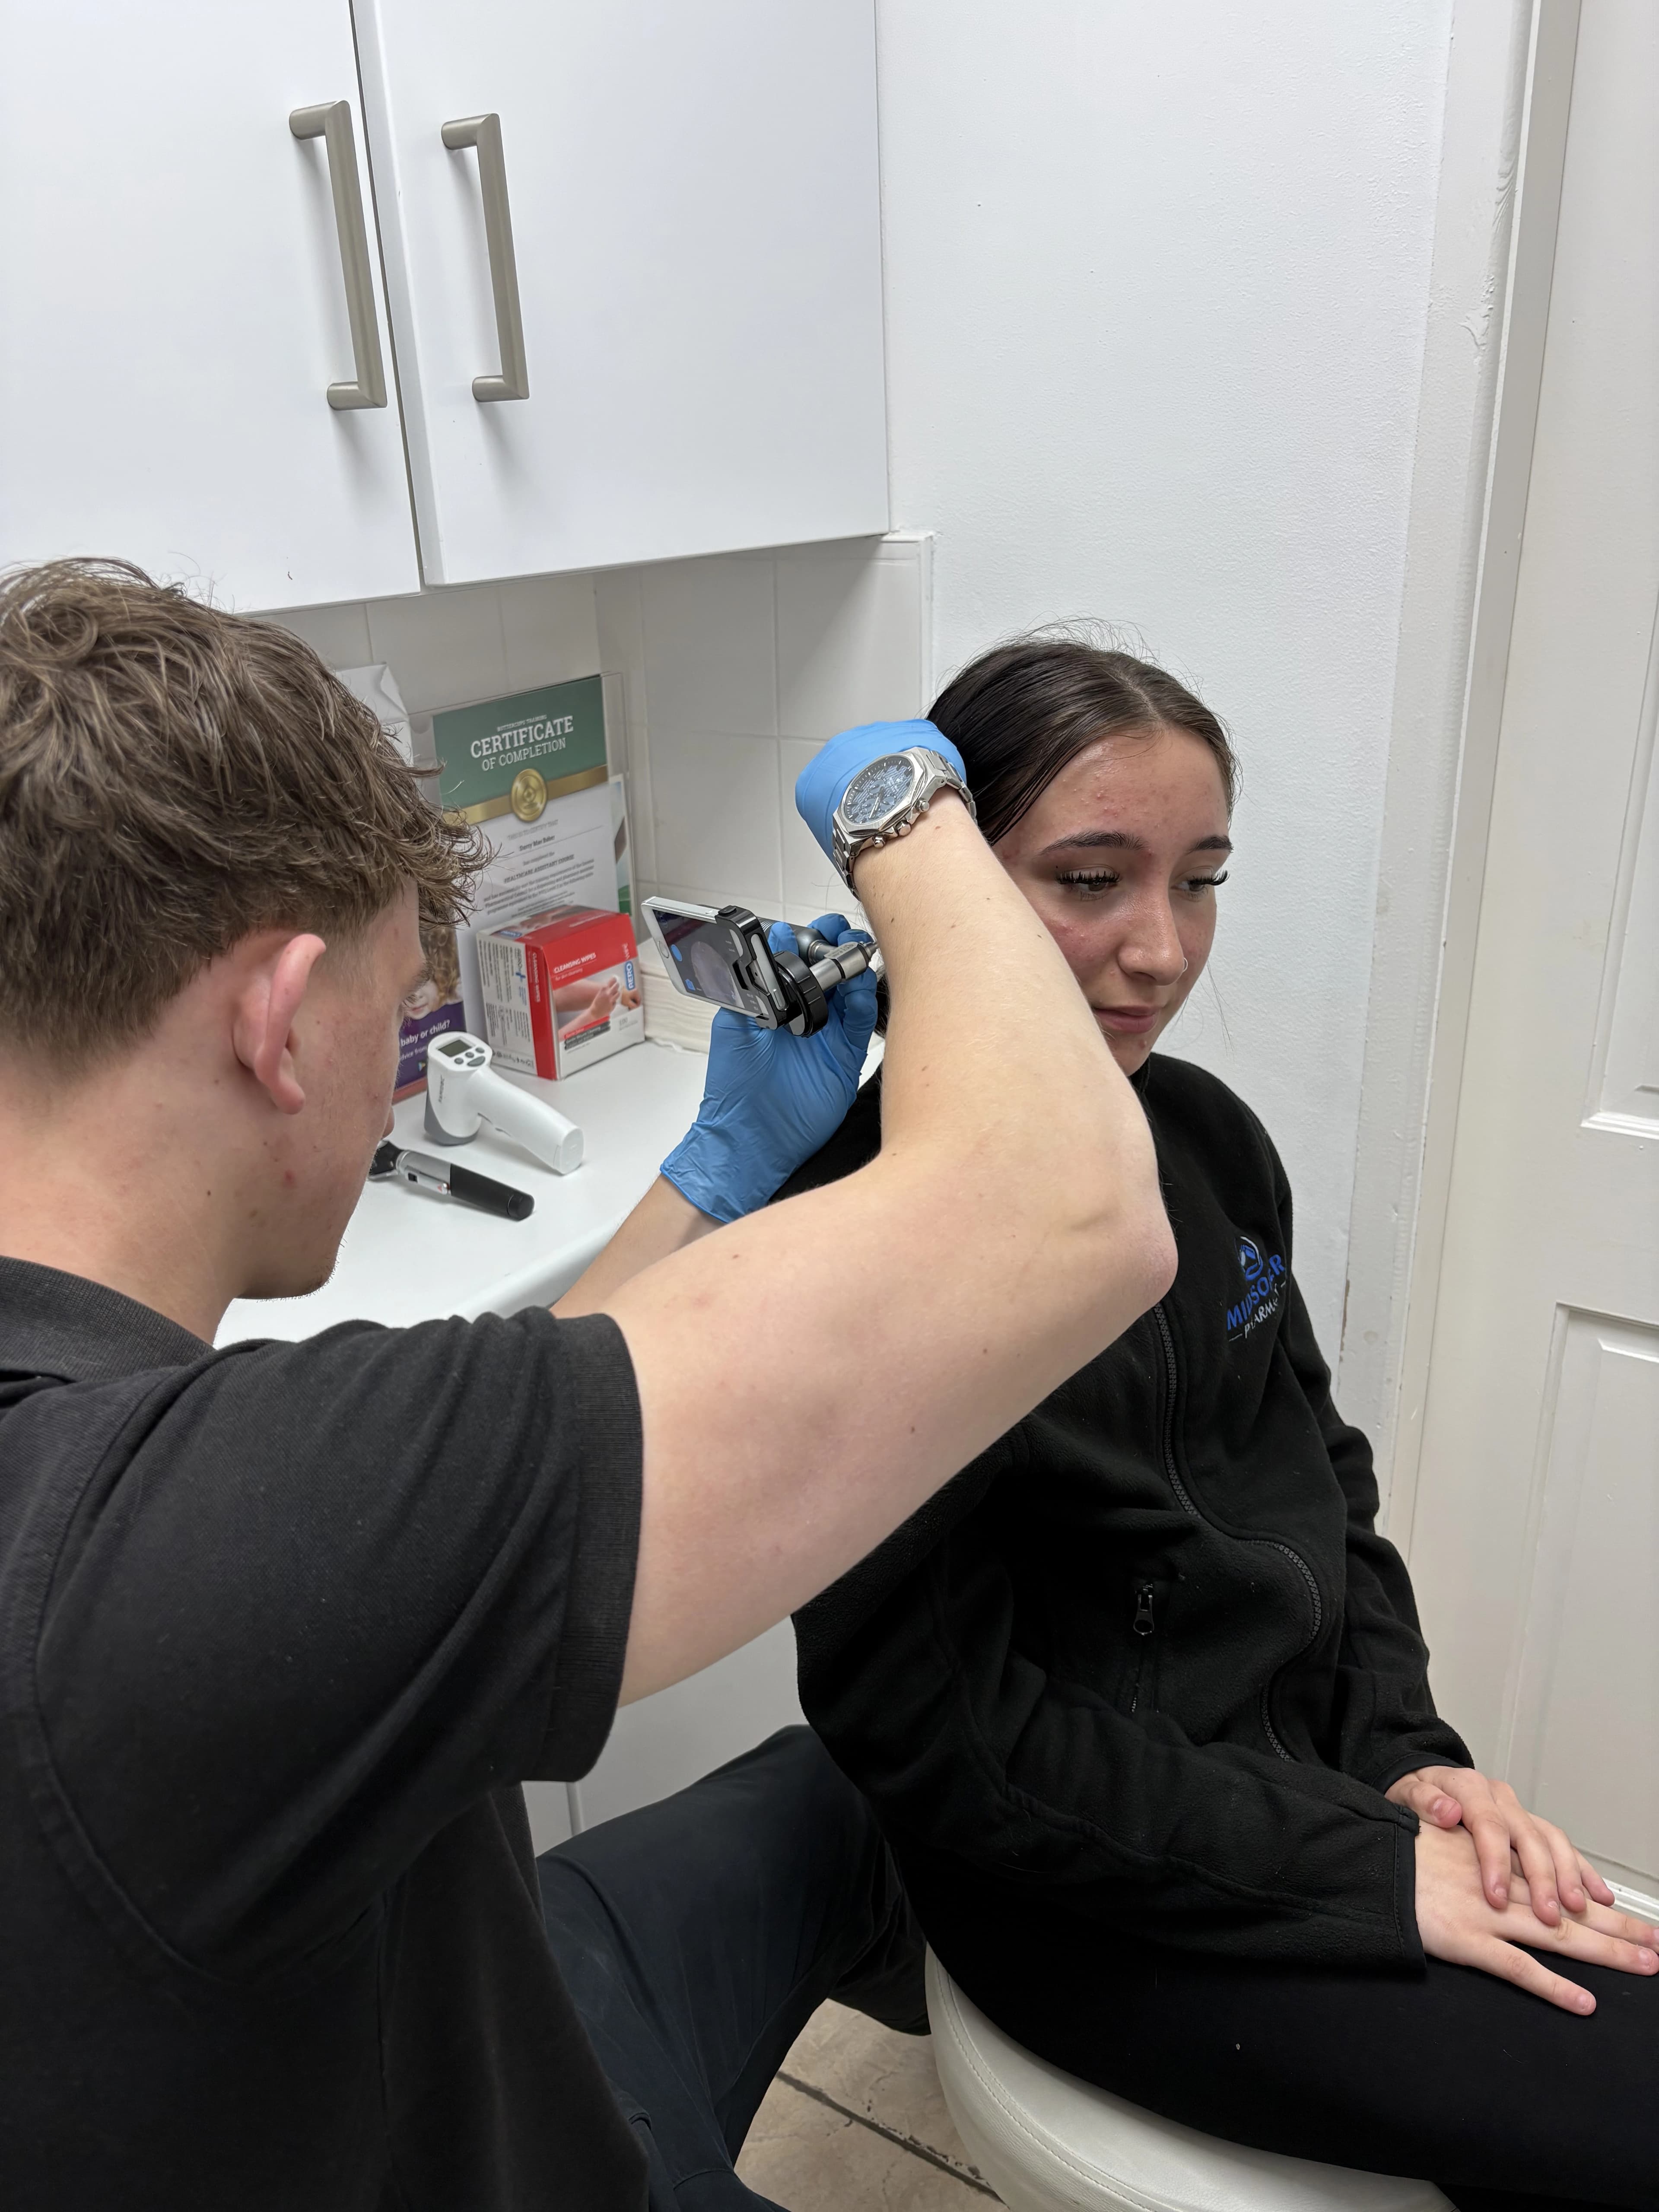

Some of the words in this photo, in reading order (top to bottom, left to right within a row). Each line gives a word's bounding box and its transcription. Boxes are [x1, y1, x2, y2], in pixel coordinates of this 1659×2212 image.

[470, 715, 574, 758] CERTIFICATE
[482, 757, 496, 771] OF
[499, 737, 566, 766] COMPLETION
[553, 959, 581, 973] CLEANSING
[581, 952, 596, 963] WIPES
[400, 1034, 419, 1046] baby
[420, 1030, 428, 1039] or
[429, 1019, 450, 1034] child?
